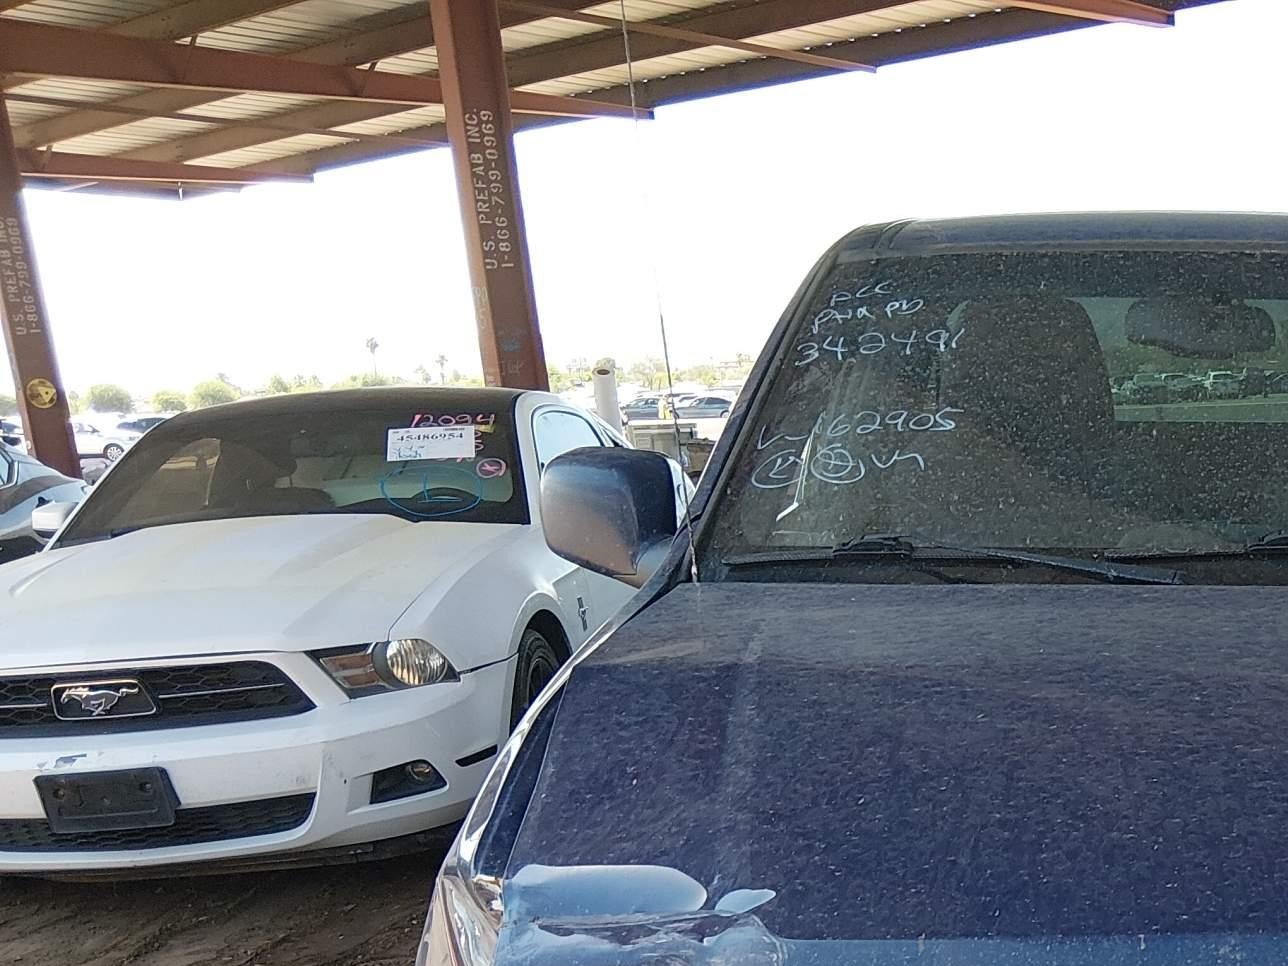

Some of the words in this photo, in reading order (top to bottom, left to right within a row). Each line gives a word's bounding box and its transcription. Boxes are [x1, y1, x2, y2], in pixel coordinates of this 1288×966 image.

[465, 107, 482, 144] INC.
[471, 153, 493, 225] PREFAB
[480, 110, 515, 269] 1-866-799-0969
[483, 235, 498, 270] U.S.
